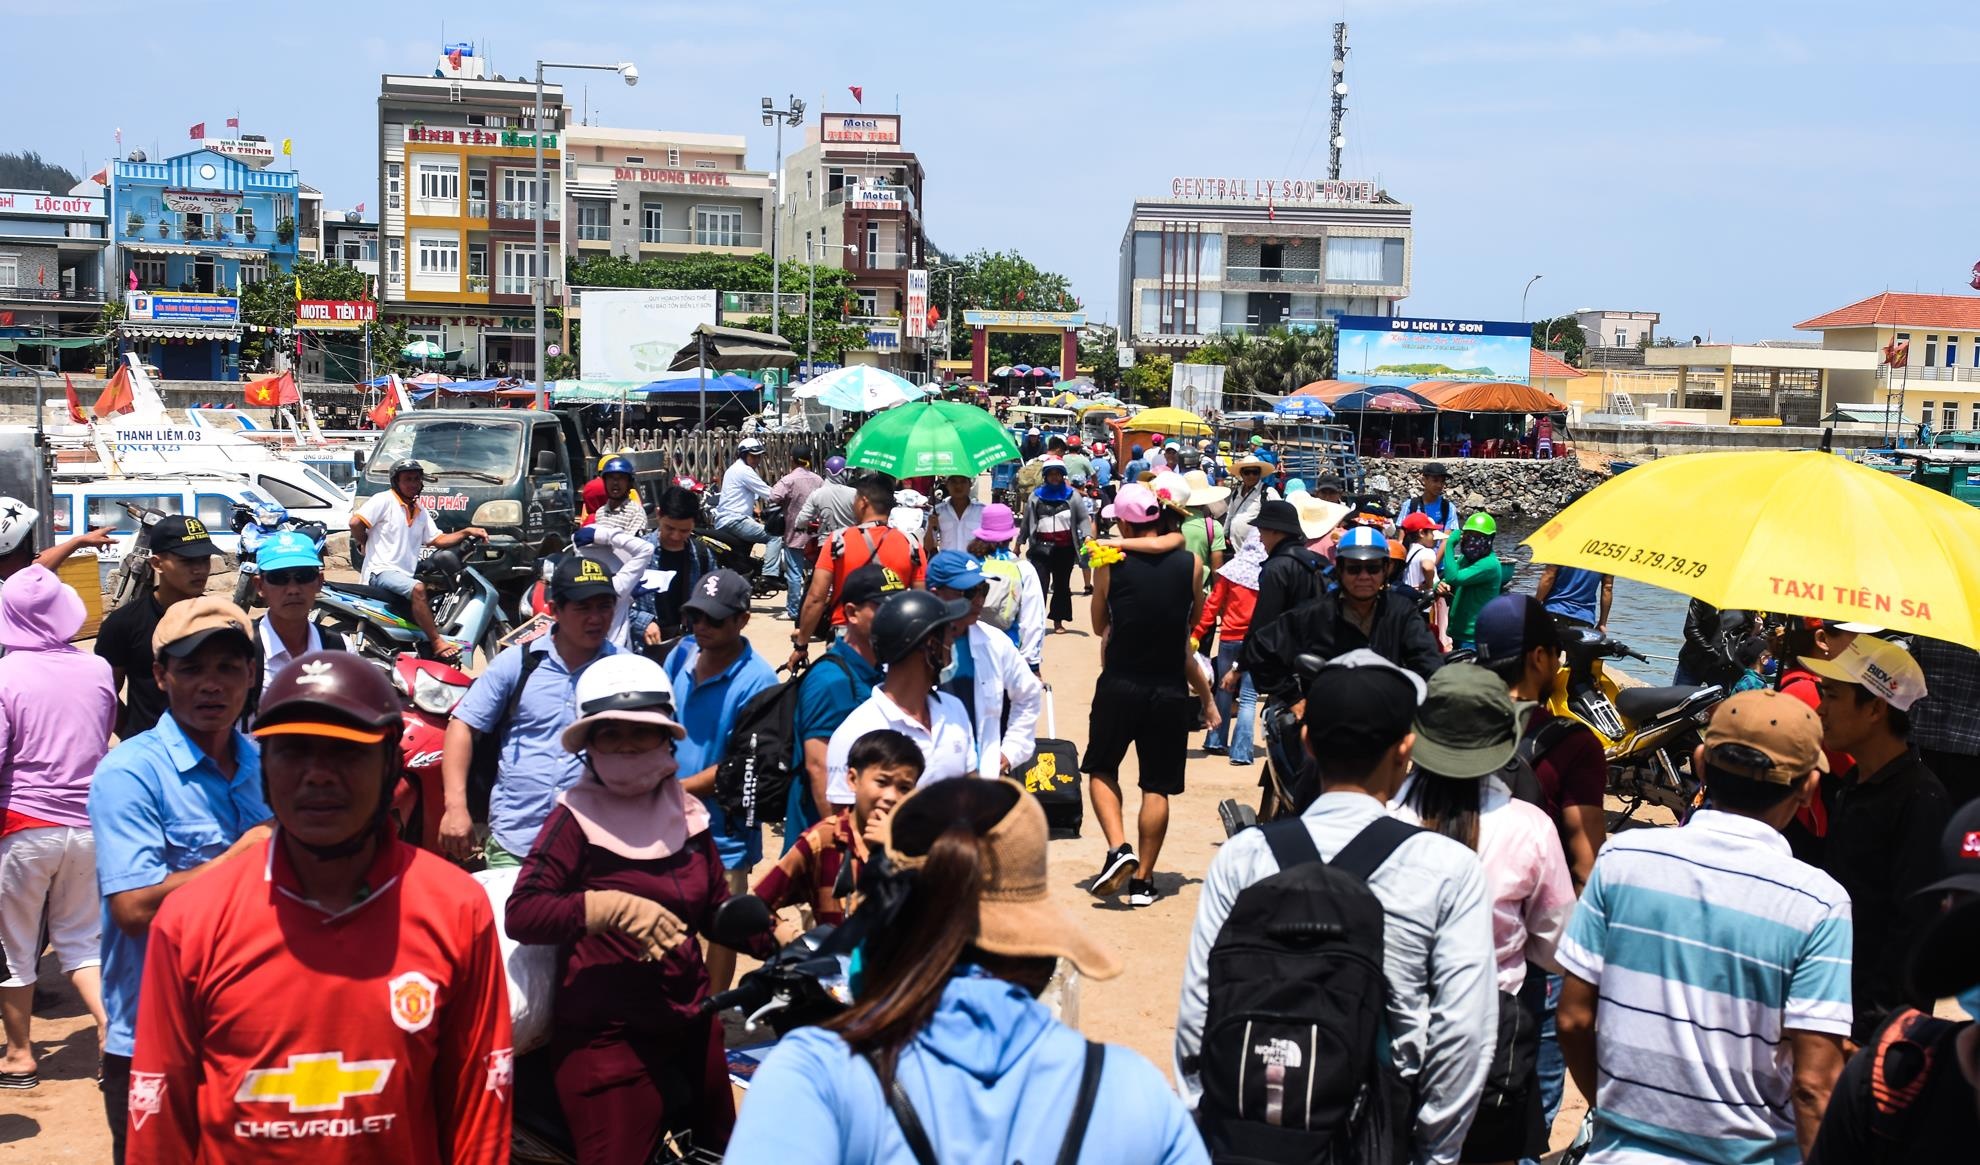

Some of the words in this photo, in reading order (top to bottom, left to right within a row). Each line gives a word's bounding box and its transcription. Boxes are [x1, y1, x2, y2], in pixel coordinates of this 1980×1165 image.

[843, 119, 877, 128] Motel
[459, 128, 497, 144] YÊN
[237, 147, 272, 155] THỊNH
[689, 171, 730, 187] HOTEL
[862, 191, 893, 200] Motel
[1172, 177, 1249, 197] CENTRAL
[1323, 181, 1380, 203] HOTEL
[34, 196, 61, 213] LỘC
[300, 304, 331, 319] MOTEL
[335, 302, 355, 320] TIÊN
[502, 316, 562, 329] Moel
[1392, 320, 1409, 329] DU
[1411, 321, 1438, 332] LỊCH
[1440, 320, 1456, 331] LÝ
[116, 430, 153, 441] THANH
[117, 444, 148, 454] QNG
[1579, 539, 1631, 562] (0255)
[1629, 549, 1708, 579] 3.79.79.79
[1769, 576, 1825, 601] TAXI
[1833, 586, 1892, 613] TIÊN
[1900, 599, 1932, 621] SA
[1867, 663, 1892, 683] BIDV
[1270, 1037, 1288, 1050] THE
[1254, 1044, 1288, 1057] NORTH
[1262, 1054, 1287, 1066] FACE
[234, 1113, 397, 1139] CHEVROLET
